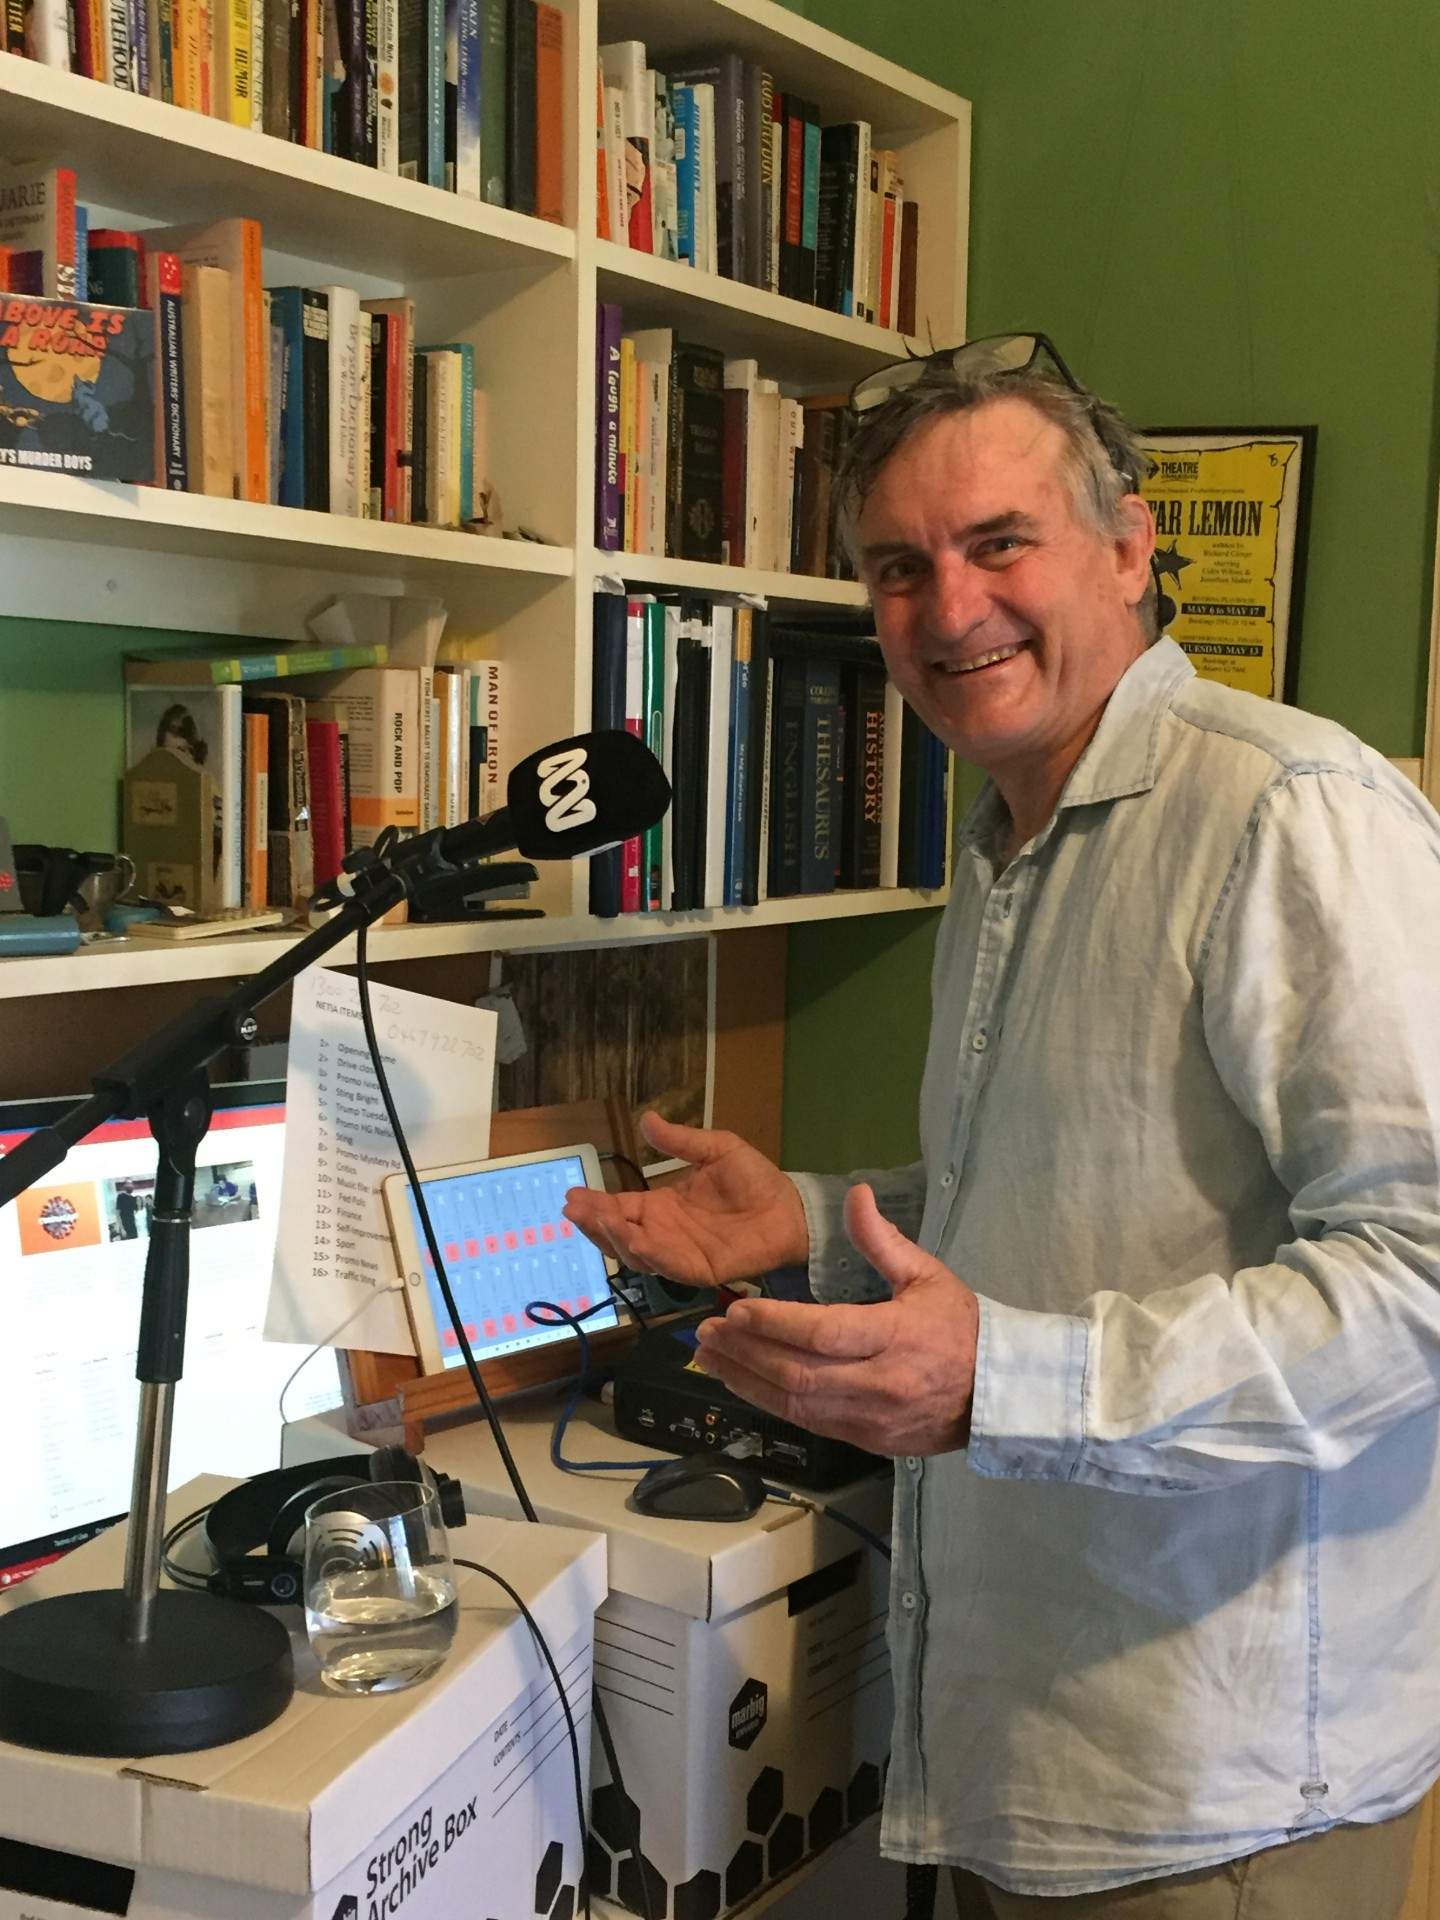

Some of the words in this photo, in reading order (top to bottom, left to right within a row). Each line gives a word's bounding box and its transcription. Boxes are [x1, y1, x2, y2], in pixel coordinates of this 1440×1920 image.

[385, 6, 395, 42] Contain
[386, 43, 396, 63] Nuts
[235, 48, 248, 98] HUMOR
[0, 300, 79, 331] BOVE
[0, 325, 21, 347] A
[166, 299, 177, 357] AUSTRALIAN
[609, 346, 620, 362] A
[170, 403, 181, 457] DICTIONARY
[608, 434, 618, 484] minute
[1161, 461, 1199, 474] THEATRE
[1187, 500, 1264, 537] LEMON
[1187, 605, 1207, 613] MAY
[1216, 606, 1225, 615] to
[1226, 607, 1247, 615] MAY
[1249, 607, 1260, 615] 17
[1183, 643, 1223, 654] TUESDAY
[1225, 646, 1247, 655] MAY
[1249, 647, 1260, 655] 13
[488, 666, 499, 705] MAN
[394, 712, 404, 742] ROCK
[488, 710, 499, 733] OF
[394, 745, 403, 768] AND
[488, 739, 499, 784] IRON
[864, 711, 878, 824] HISTORY
[394, 771, 403, 794] POP
[423, 761, 431, 800] DEMOCRACY
[814, 714, 833, 860] THESAURUS
[783, 721, 800, 867] ENGLISH
[337, 1043, 370, 1060] Opening
[337, 1058, 357, 1070] Drive
[336, 1072, 362, 1087] Promo
[335, 1087, 355, 1101] Sting
[356, 1093, 379, 1105] Bright
[335, 1102, 360, 1117] Trump
[335, 1117, 360, 1131] Promo
[361, 1124, 373, 1134] HG
[335, 1132, 353, 1146] Sting
[335, 1146, 360, 1161] Promo
[360, 1153, 390, 1169] Mystery
[390, 1159, 402, 1170] Rd
[317, 1173, 332, 1183] 10>
[317, 1189, 332, 1199] 11>
[316, 1204, 332, 1214] 12>
[315, 1220, 331, 1230] 13>
[314, 1235, 331, 1245] 14>
[335, 1238, 356, 1249] Sport
[313, 1251, 330, 1261] 15>
[335, 1253, 360, 1266] Promo
[312, 1267, 329, 1277] 16>
[335, 1269, 359, 1282] Traffic
[731, 1693, 765, 1729] marbig
[493, 1720, 509, 1744] DATE
[493, 1730, 522, 1767] CONTENTS
[366, 1806, 433, 1899] Strong
[367, 1839, 440, 1920] Archive
[444, 1796, 478, 1853] Box
